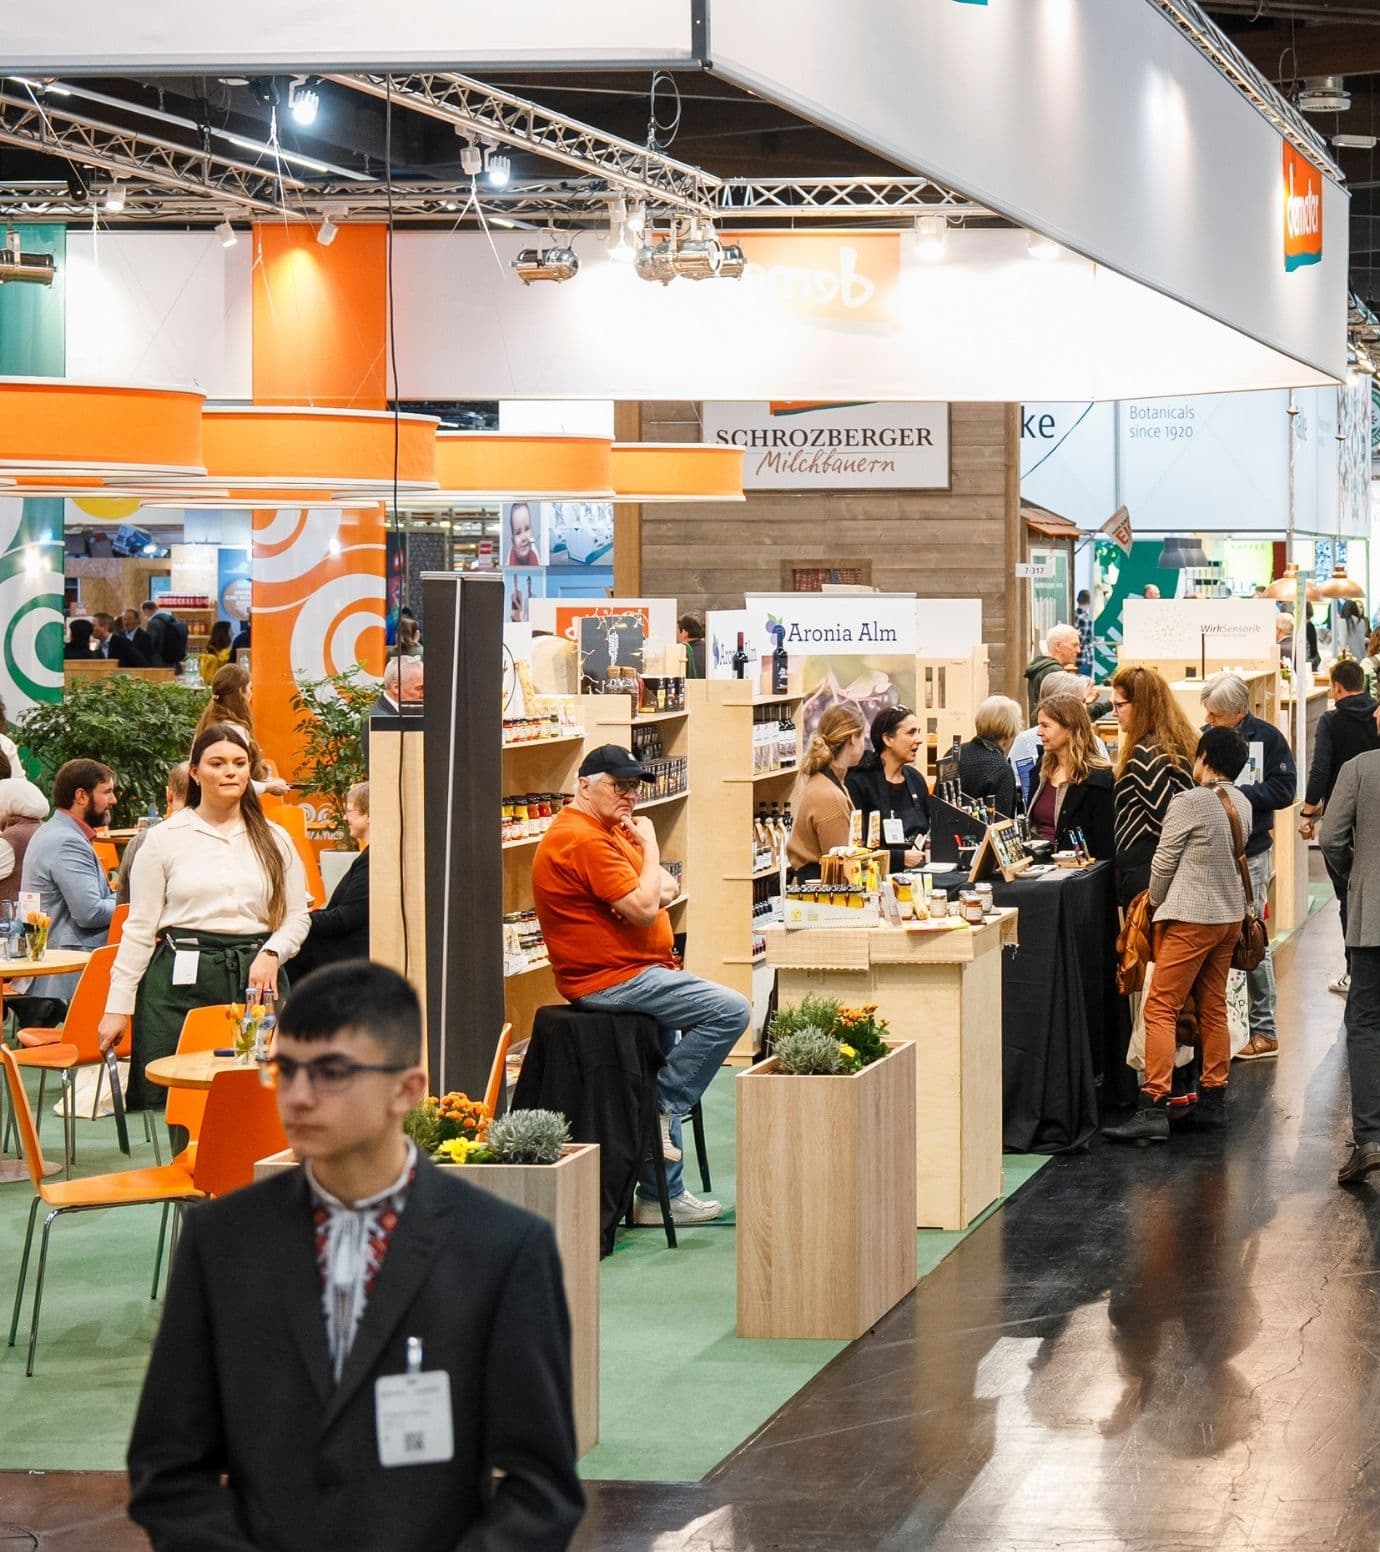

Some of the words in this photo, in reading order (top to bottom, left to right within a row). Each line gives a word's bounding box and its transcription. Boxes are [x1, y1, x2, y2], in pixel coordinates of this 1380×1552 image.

[1129, 406, 1195, 420] Botanicals
[716, 427, 933, 447] SCHROZBERGER
[1129, 425, 1161, 438] since
[1165, 426, 1193, 440] 1920
[756, 447, 896, 475] Milchbauern
[787, 622, 852, 642] Aronia
[858, 621, 897, 642] Alm
